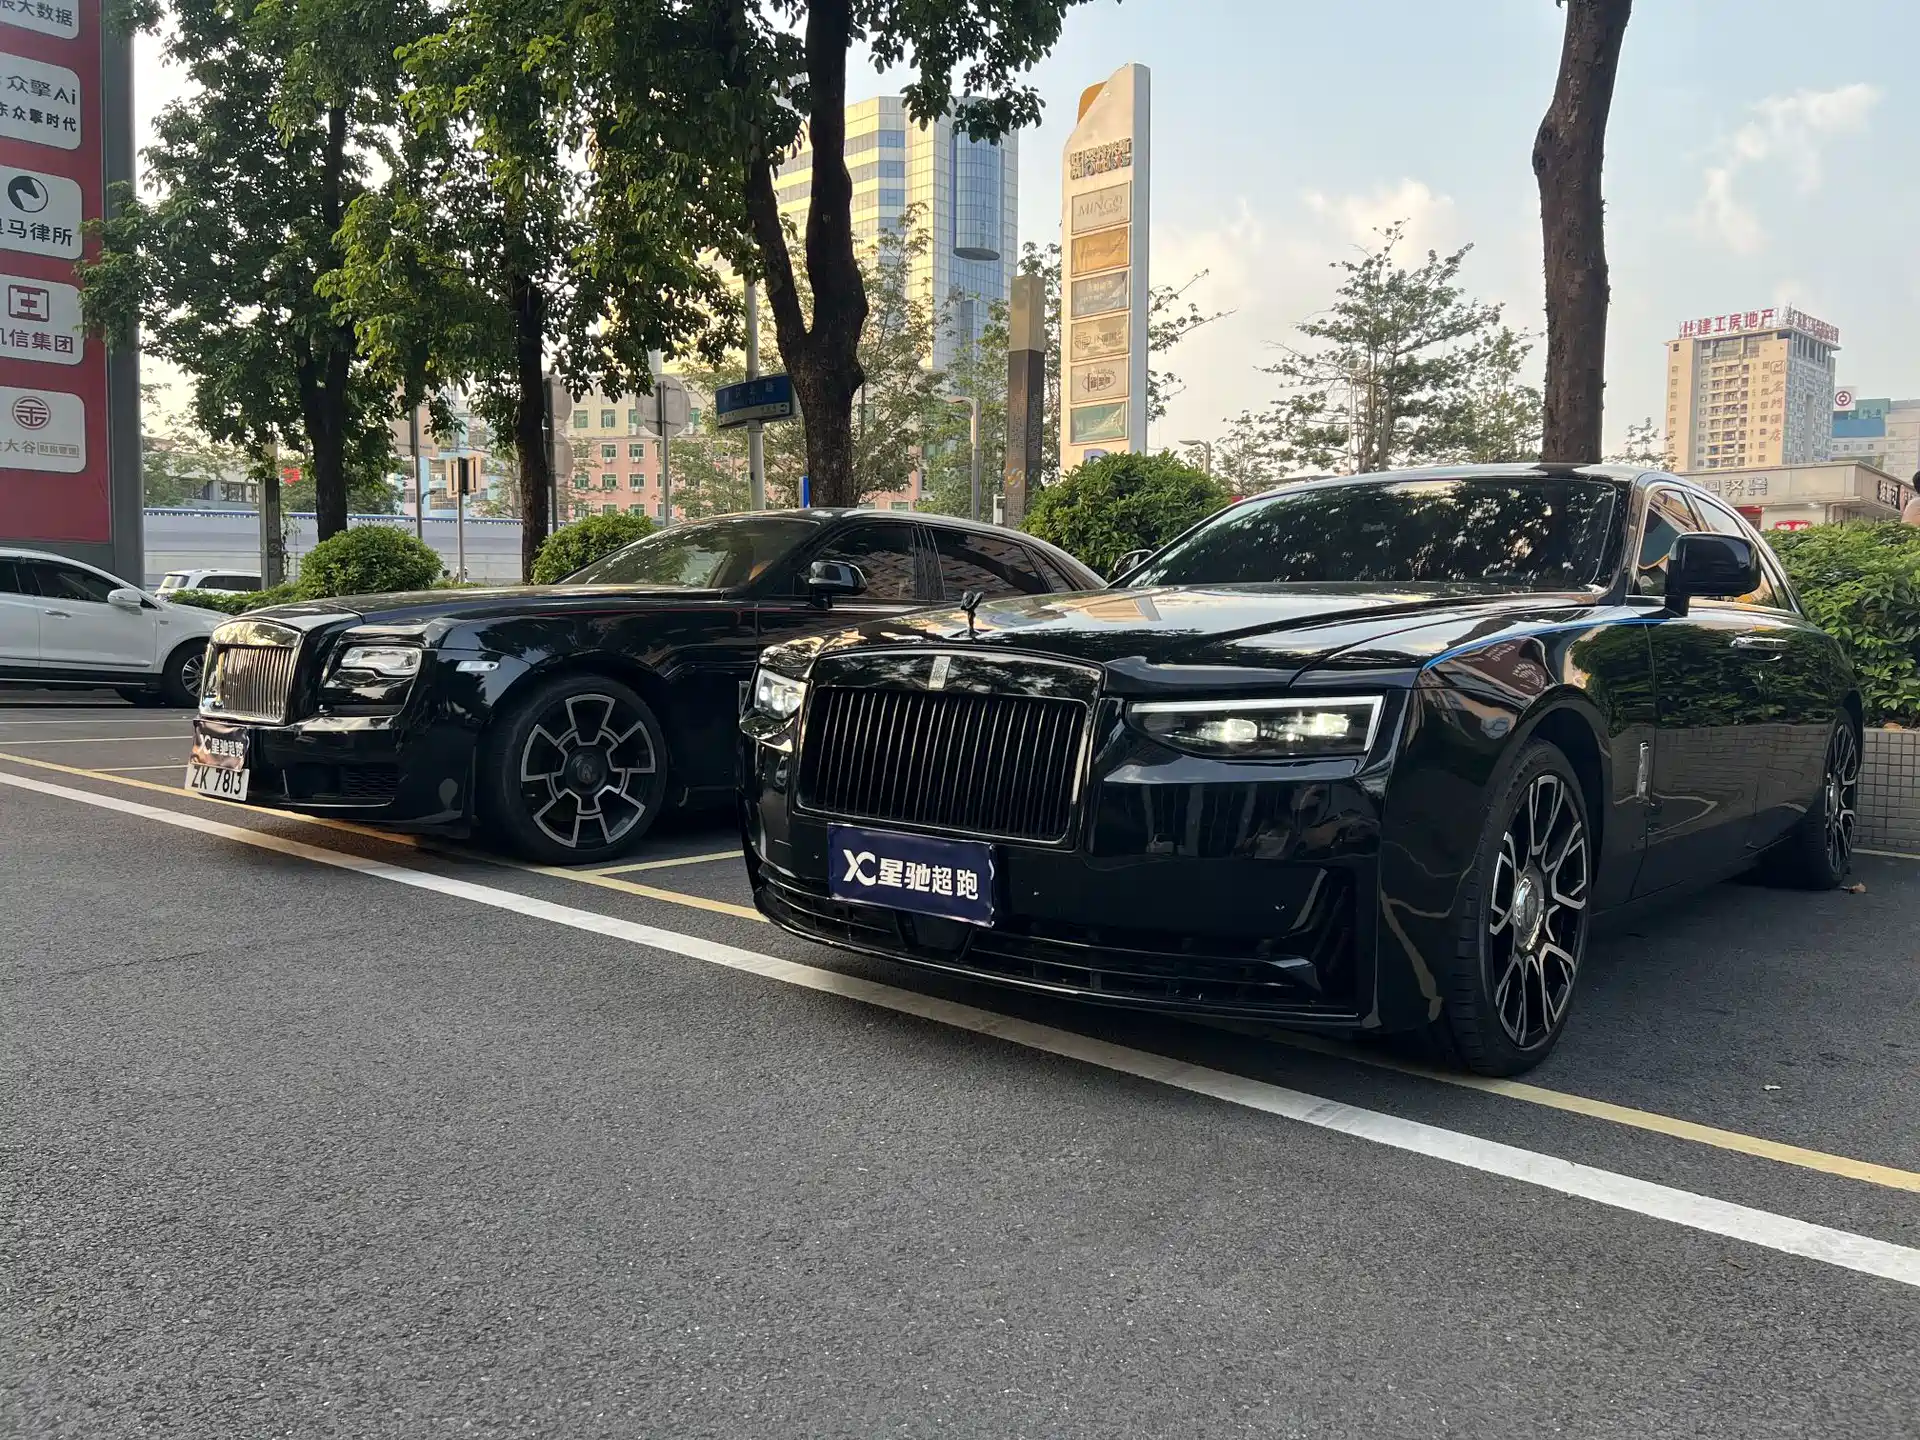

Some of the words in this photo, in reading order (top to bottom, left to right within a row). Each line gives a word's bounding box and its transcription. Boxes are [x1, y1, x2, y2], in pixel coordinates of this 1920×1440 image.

[0, 218, 73, 247] 马律所
[0, 438, 37, 454] 大谷
[878, 857, 979, 900] 星驰超跑
